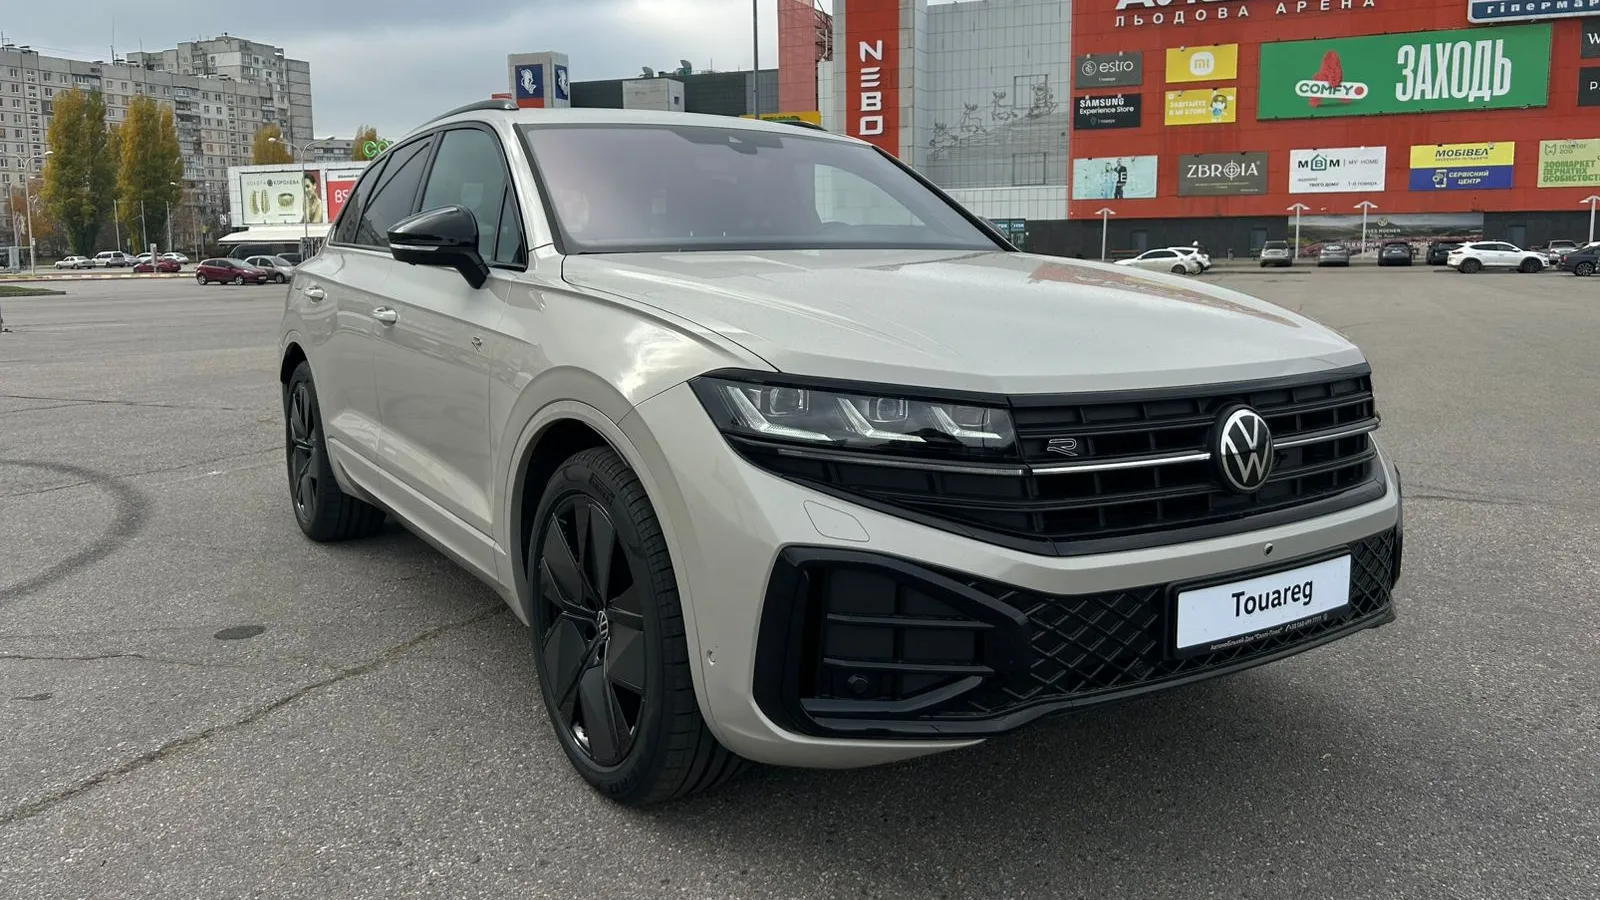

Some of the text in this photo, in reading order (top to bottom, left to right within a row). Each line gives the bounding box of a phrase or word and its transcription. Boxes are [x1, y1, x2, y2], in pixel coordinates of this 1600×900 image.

[1115, 0, 1374, 27] ЛЬОДОВА АРЕНА
[1099, 60, 1134, 72] estro
[1396, 39, 1512, 103] ЗАХОДЬ
[859, 40, 883, 135] NEBO
[1299, 82, 1354, 96] COMFY
[1080, 98, 1125, 107] SAMSUNG
[1080, 106, 1116, 115] Experience
[1435, 148, 1488, 157] МОБІВЕЛ
[1544, 160, 1596, 169] ЗООМАРКЕТ
[1449, 170, 1489, 178] СЕРВІСНИЙ
[1231, 580, 1313, 617] Touareg
